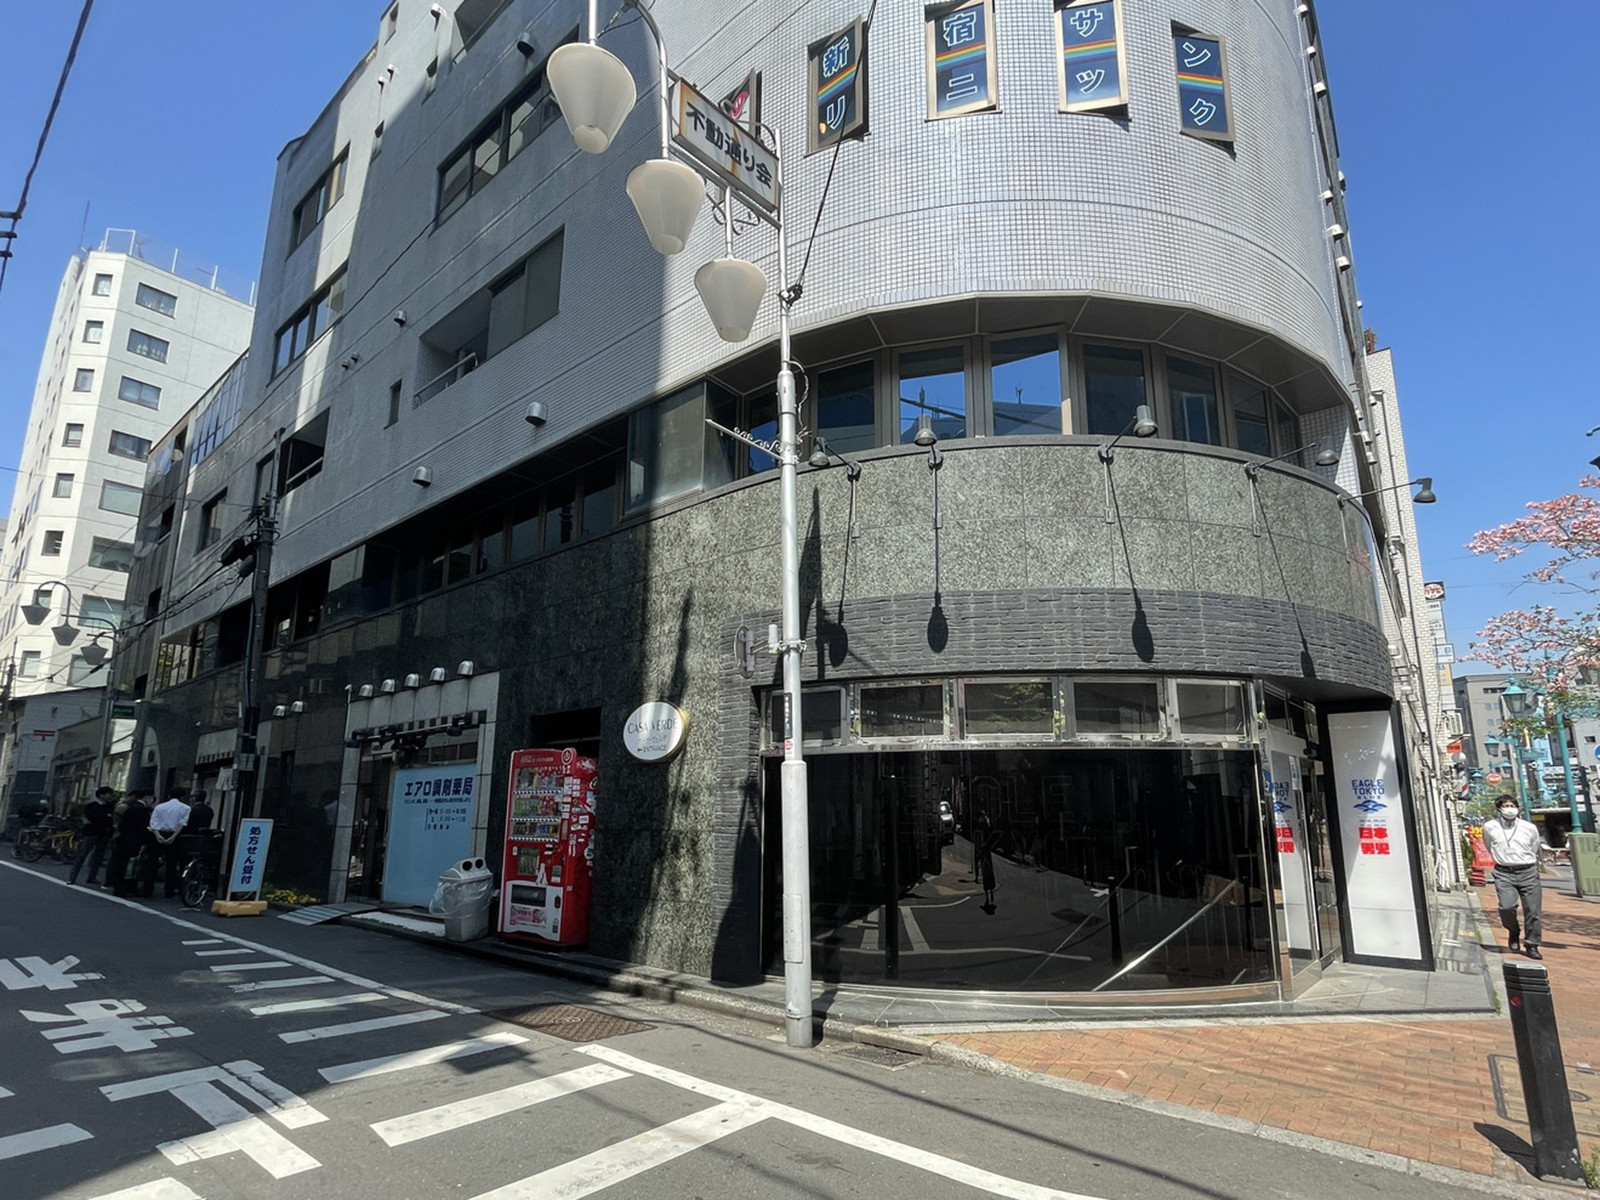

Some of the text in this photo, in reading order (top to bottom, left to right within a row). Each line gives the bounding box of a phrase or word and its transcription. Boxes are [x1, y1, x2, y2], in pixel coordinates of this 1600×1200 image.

[686, 101, 772, 190] 不動通り会
[1351, 779, 1384, 788] EAGLE
[1352, 786, 1385, 796] TOKYO
[240, 826, 262, 885] 処方せん受付
